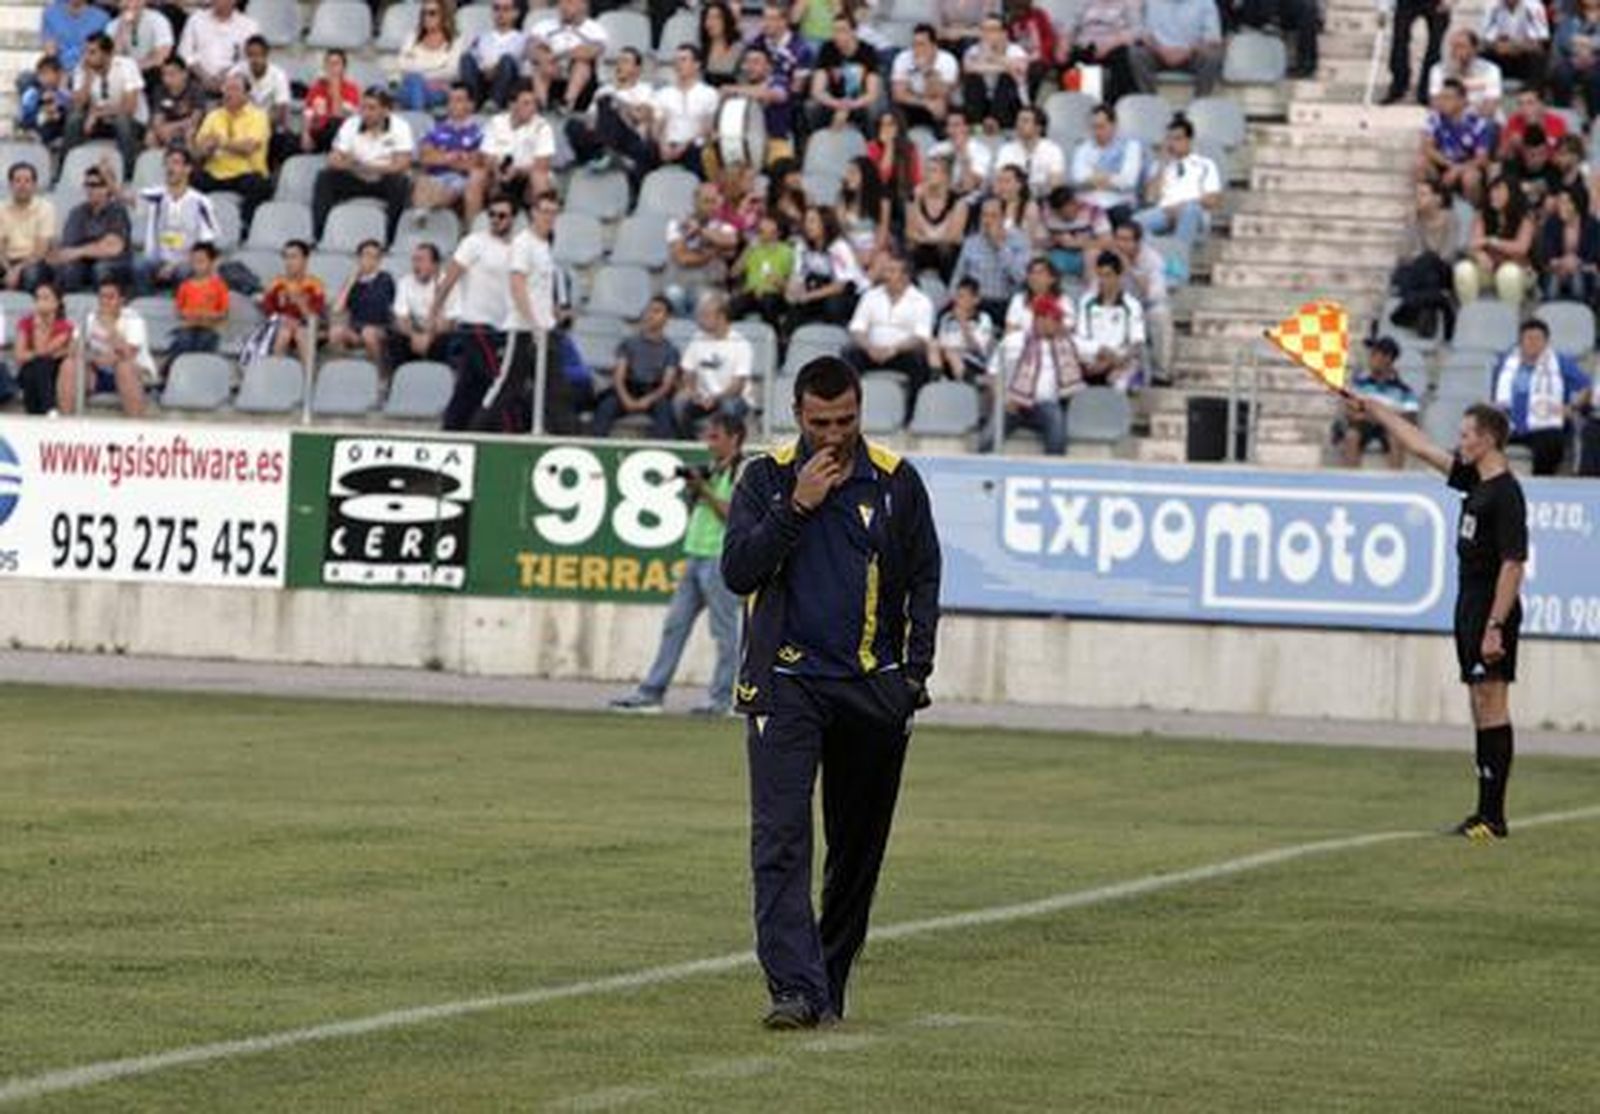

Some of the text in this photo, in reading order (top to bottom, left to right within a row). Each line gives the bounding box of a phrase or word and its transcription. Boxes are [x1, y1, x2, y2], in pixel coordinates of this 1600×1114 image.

[39, 435, 283, 487] www.gsisoftware.es
[348, 445, 461, 465] ONDA
[532, 446, 688, 548] 98
[52, 512, 278, 576] 953 275 452
[330, 526, 457, 560] CERO
